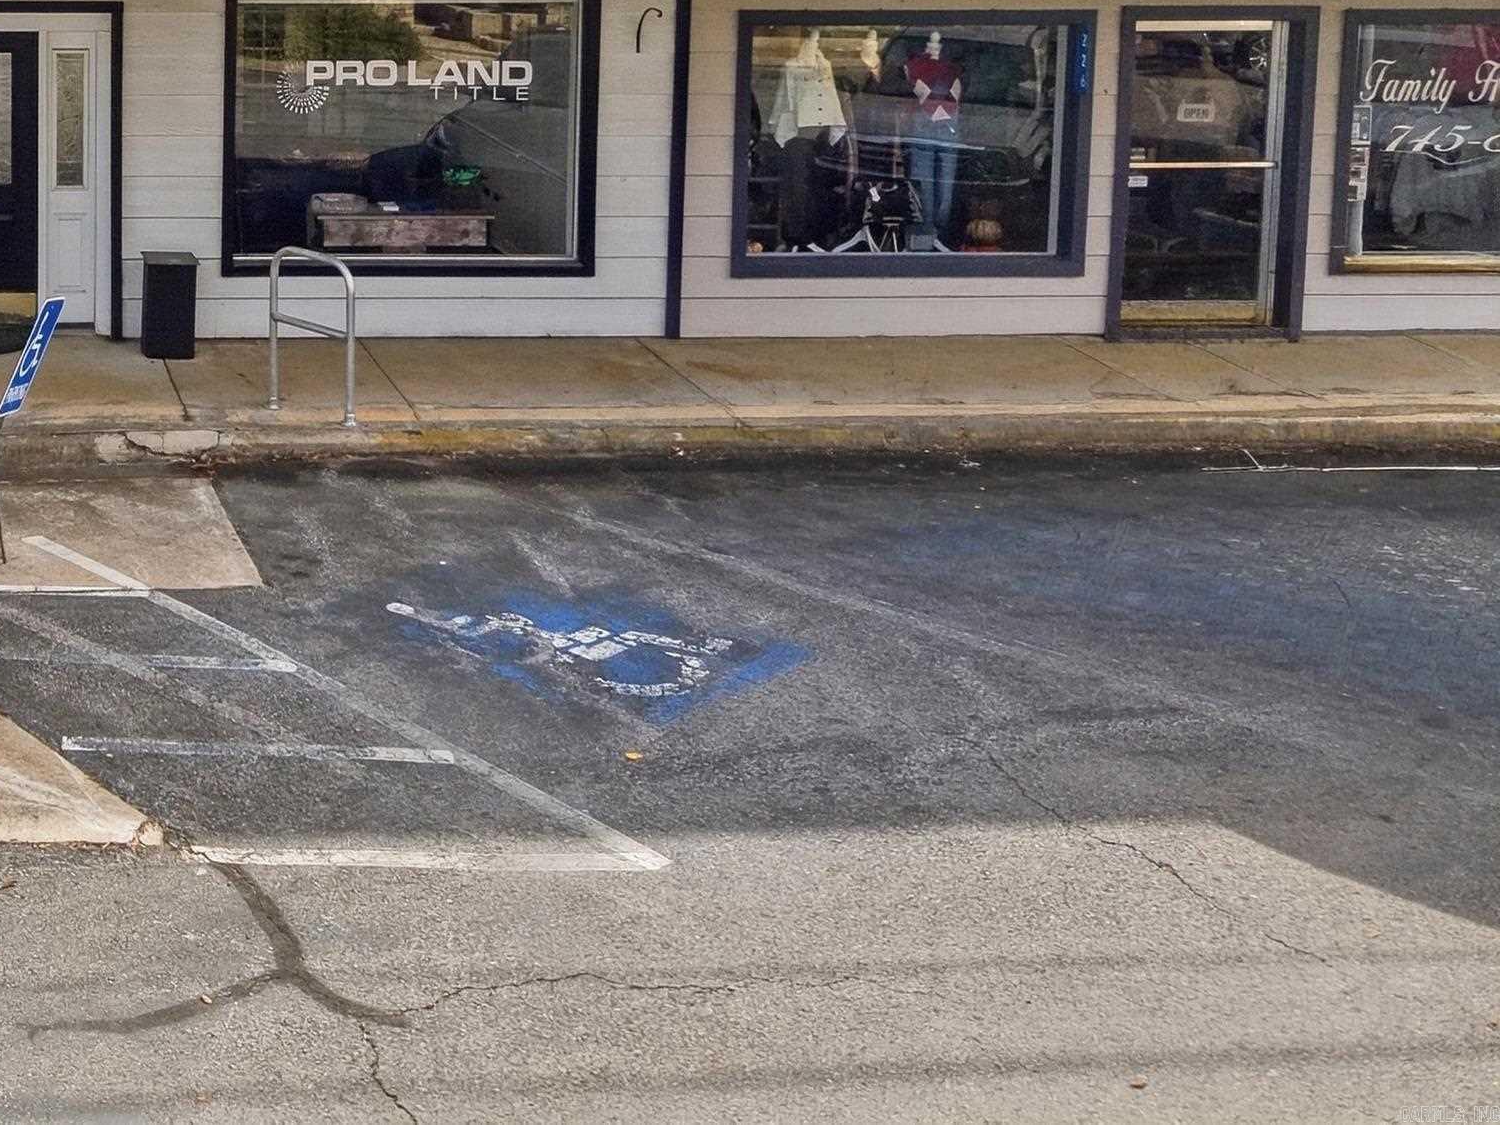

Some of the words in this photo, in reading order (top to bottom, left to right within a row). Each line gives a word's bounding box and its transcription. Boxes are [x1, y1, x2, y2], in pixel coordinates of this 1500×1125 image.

[306, 60, 398, 86] PRO
[407, 60, 533, 86] LAND
[429, 86, 529, 100] TITLE
[1359, 59, 1457, 114] Family
